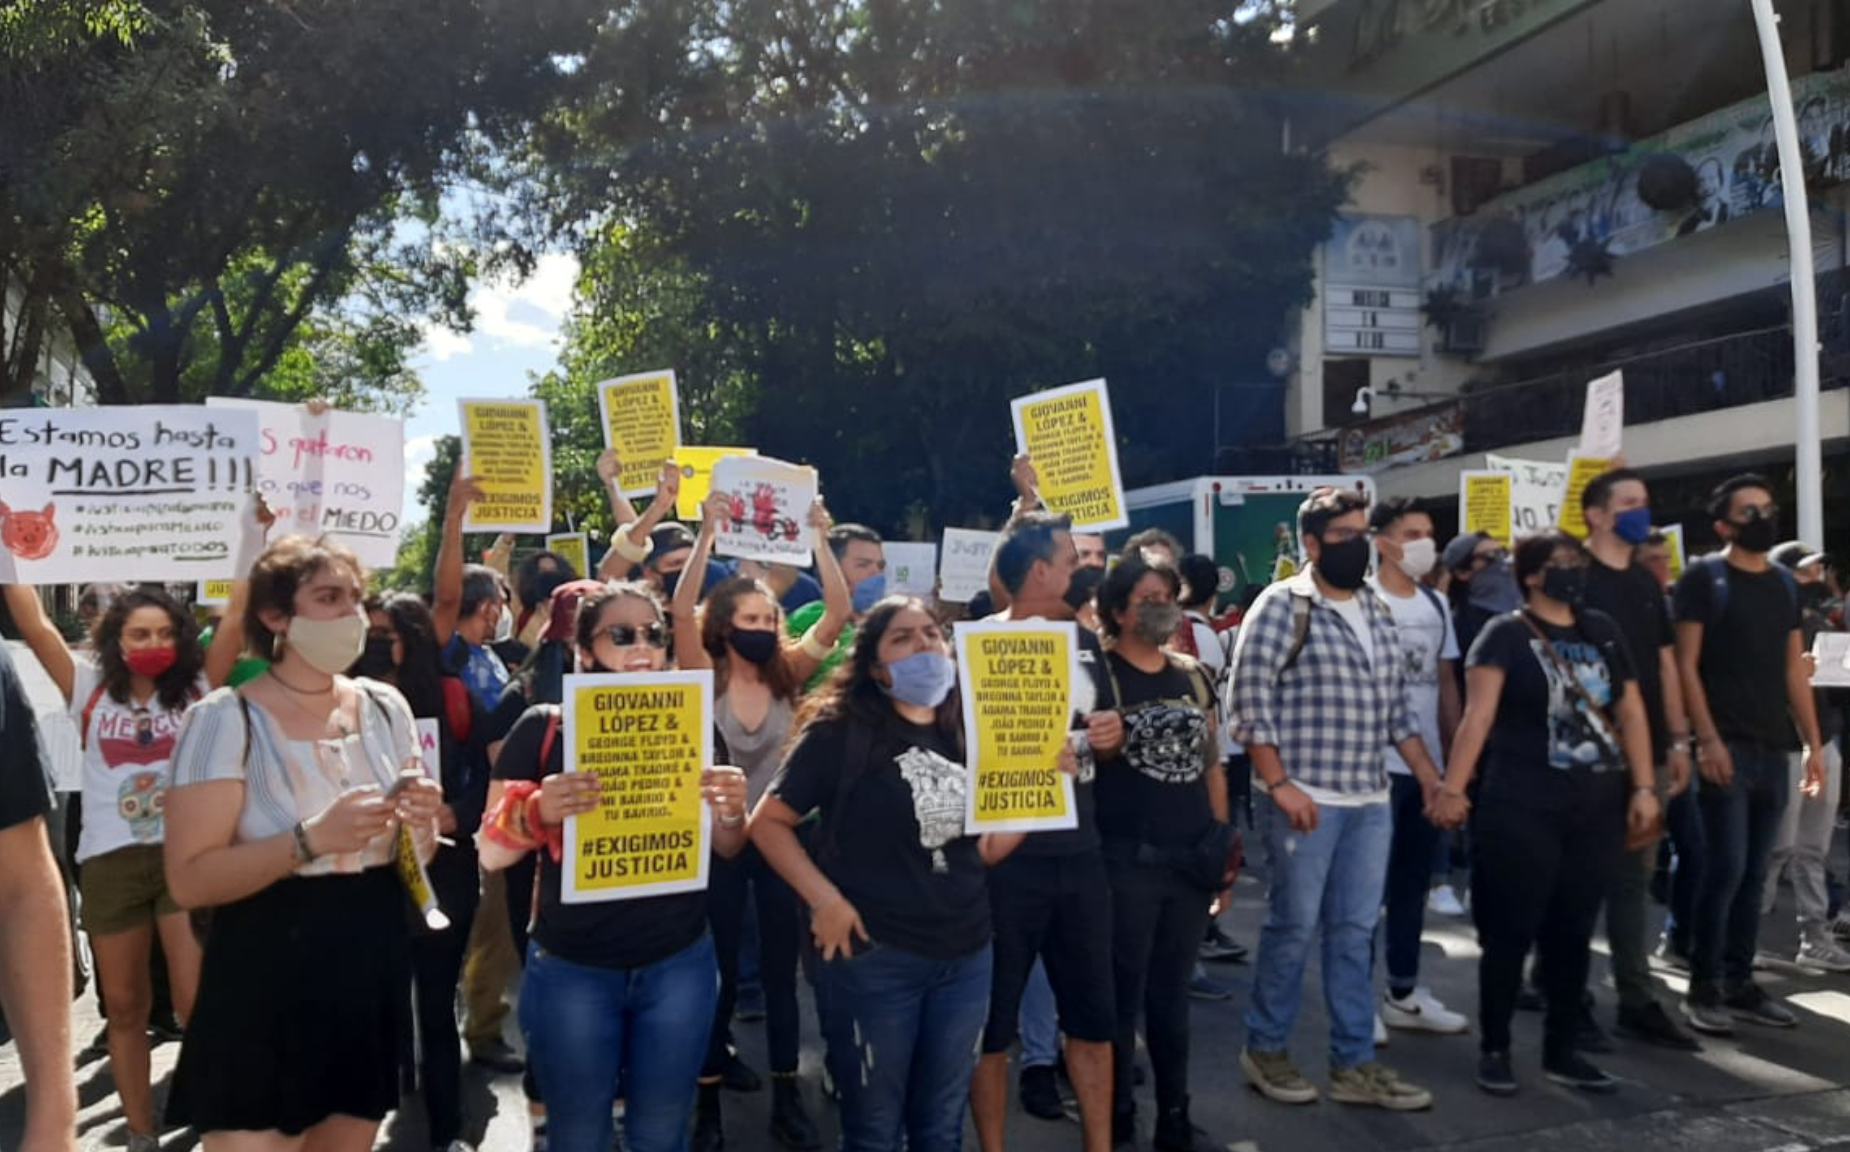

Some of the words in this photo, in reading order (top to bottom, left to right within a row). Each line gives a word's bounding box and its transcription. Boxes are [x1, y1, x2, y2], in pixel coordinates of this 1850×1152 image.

[1030, 396, 1087, 419] GIOVANNI
[1036, 413, 1073, 432] LÓPEZ
[0, 419, 140, 450] Estamos
[153, 421, 235, 450] hasta
[0, 455, 28, 478] la
[47, 456, 196, 488] MADRE
[333, 482, 372, 501] nos
[322, 507, 398, 533] MIEDO
[475, 506, 539, 519] JUSTICIA
[981, 639, 1055, 656] GIOVANNI
[988, 655, 1036, 675] LÓPEZ
[1041, 659, 1052, 675] &
[594, 690, 685, 711] GIOVANNI
[600, 710, 659, 734] LÓPEZ
[665, 713, 678, 731] &
[587, 737, 636, 749] GEORGE
[641, 735, 678, 747] FLOYD
[580, 751, 638, 765] BREONNA
[642, 748, 685, 761] TAYLOR
[630, 778, 671, 790] PEDRO
[978, 768, 1057, 789] #EXIGIMOS
[619, 792, 666, 804] BARRIO
[979, 789, 1057, 812] JUSTICIA
[604, 810, 619, 820] TU
[582, 830, 694, 857] #EXIGIMOS
[585, 852, 688, 879] JUSTICIA
